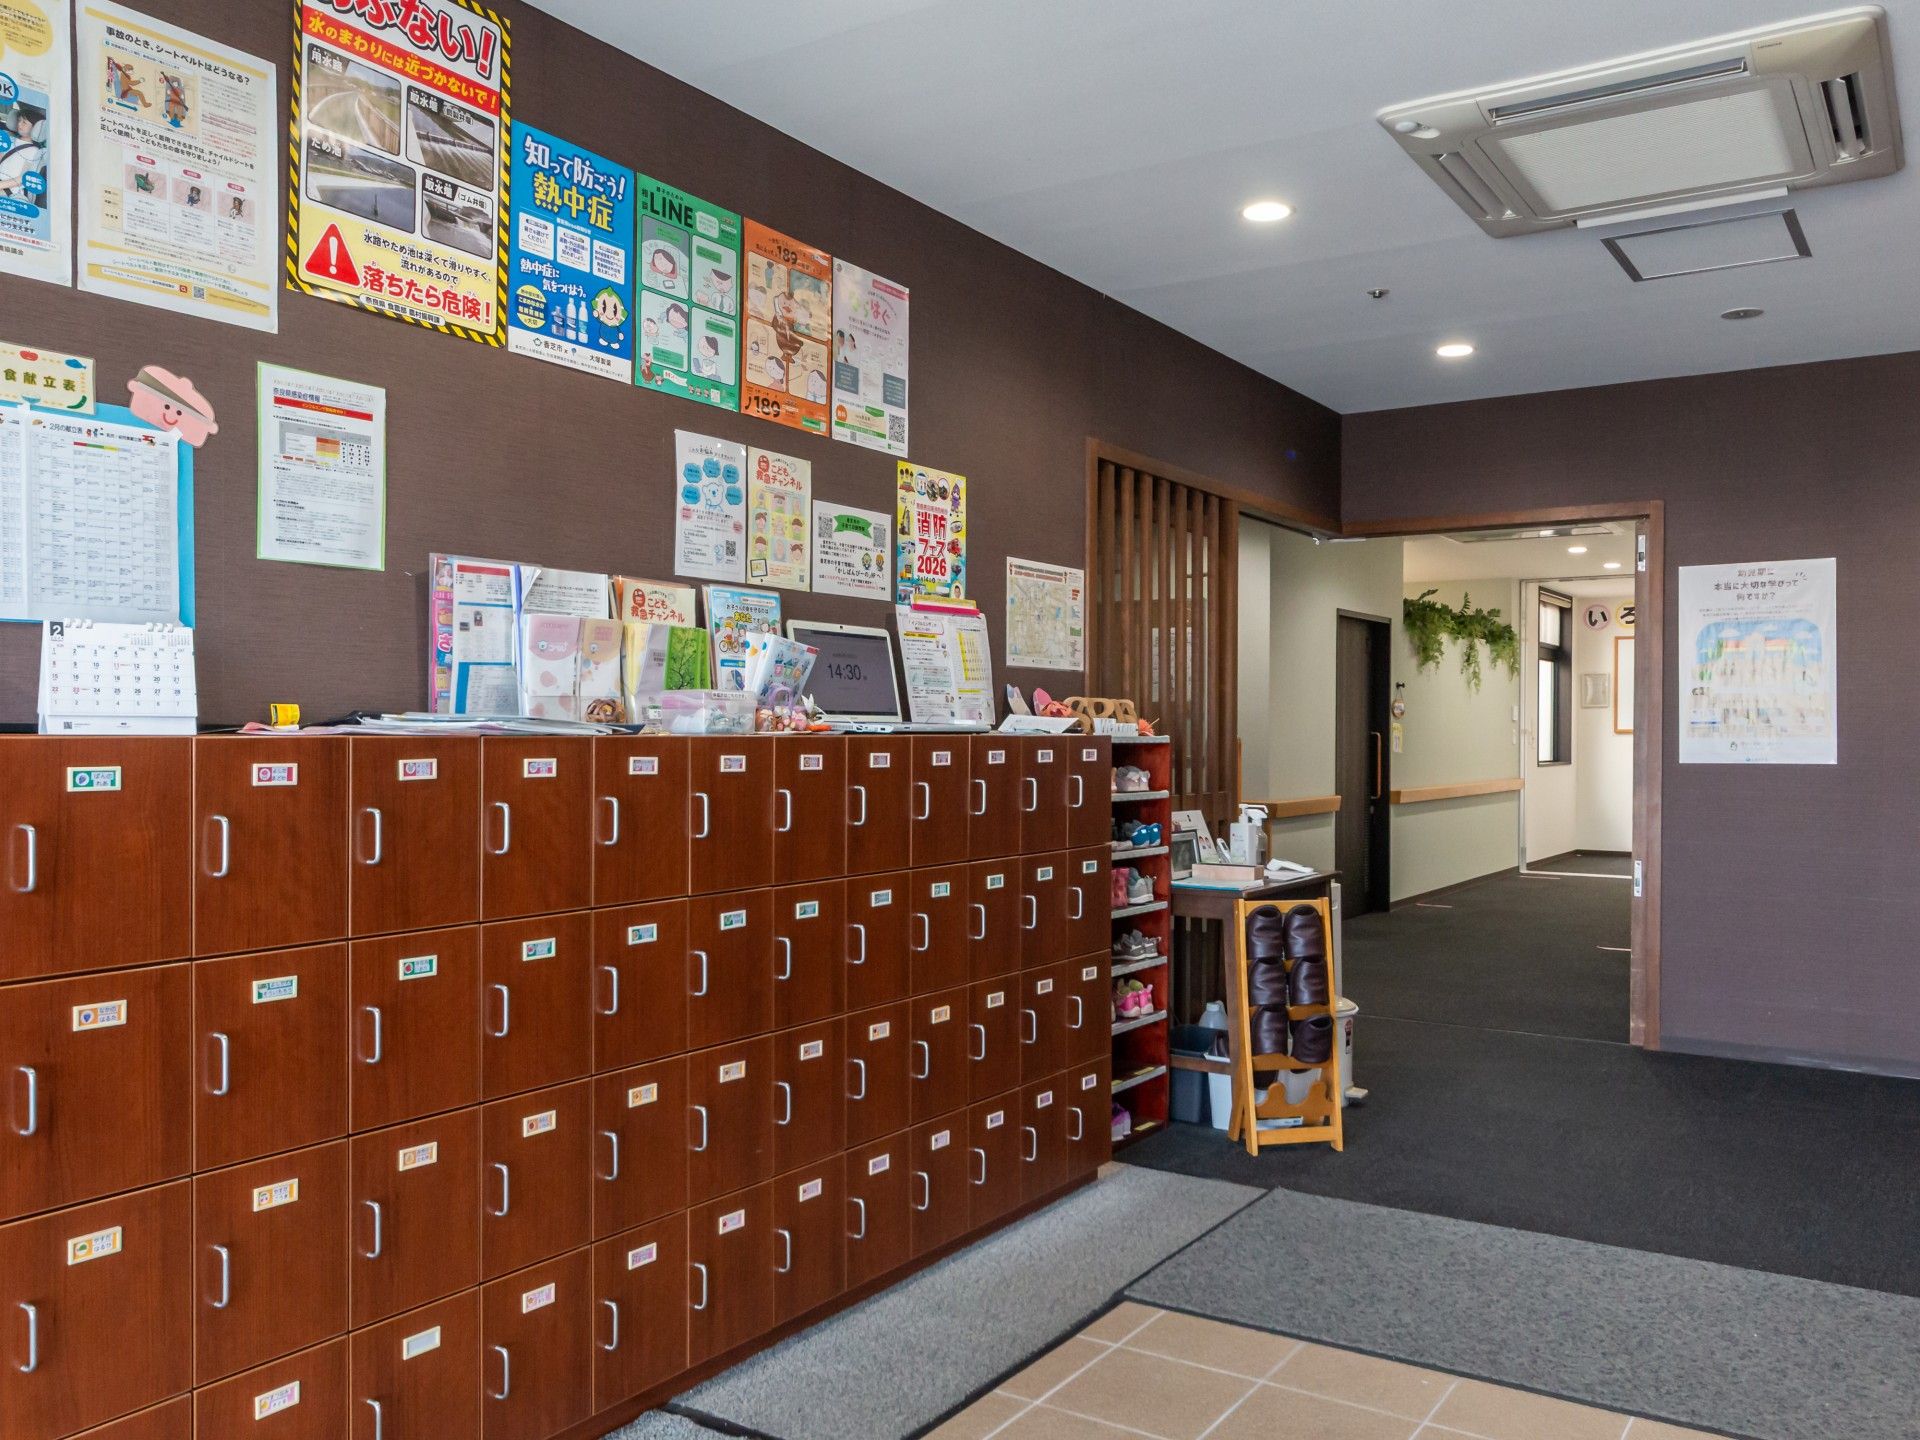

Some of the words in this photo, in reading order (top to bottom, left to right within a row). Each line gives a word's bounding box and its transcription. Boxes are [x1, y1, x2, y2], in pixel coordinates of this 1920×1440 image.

[105, 26, 250, 86] 事故のとき、シートベルトはどうなる？
[308, 14, 497, 109] 水のまわりには近づかないで！
[311, 50, 343, 73] 用水路
[311, 137, 342, 157] ため池
[525, 135, 625, 200] 知って防ごう！
[533, 171, 613, 232] 熱中症
[649, 192, 693, 229] LINE
[363, 232, 492, 282] 水路やため池は深くて滑りやすく、
[777, 245, 797, 265] 189
[400, 259, 459, 285] 流れがあるので
[520, 258, 560, 278] 熱中症に
[362, 264, 491, 324] 落ちたら危険！
[542, 278, 587, 298] 気をつけよう。
[543, 340, 563, 354] 香芝市
[589, 354, 612, 368] 大塚製薬
[4, 368, 76, 392] 食献立表
[754, 395, 781, 418] 189
[756, 469, 803, 491] 救急チャンネル
[772, 464, 788, 477] こども
[917, 511, 947, 539] 消防
[918, 538, 947, 558] フェス
[917, 555, 947, 577] 2026
[1737, 568, 1775, 577] 幼児期に
[1713, 579, 1799, 591] 本当に大切な学びって
[647, 598, 668, 610] こども
[1736, 591, 1776, 602] 何ですか？
[631, 605, 686, 623] 救急チャンネル
[1587, 609, 1608, 627] い
[1620, 607, 1635, 625] ろ
[52, 624, 61, 637] 2
[827, 663, 861, 681] 14:30
